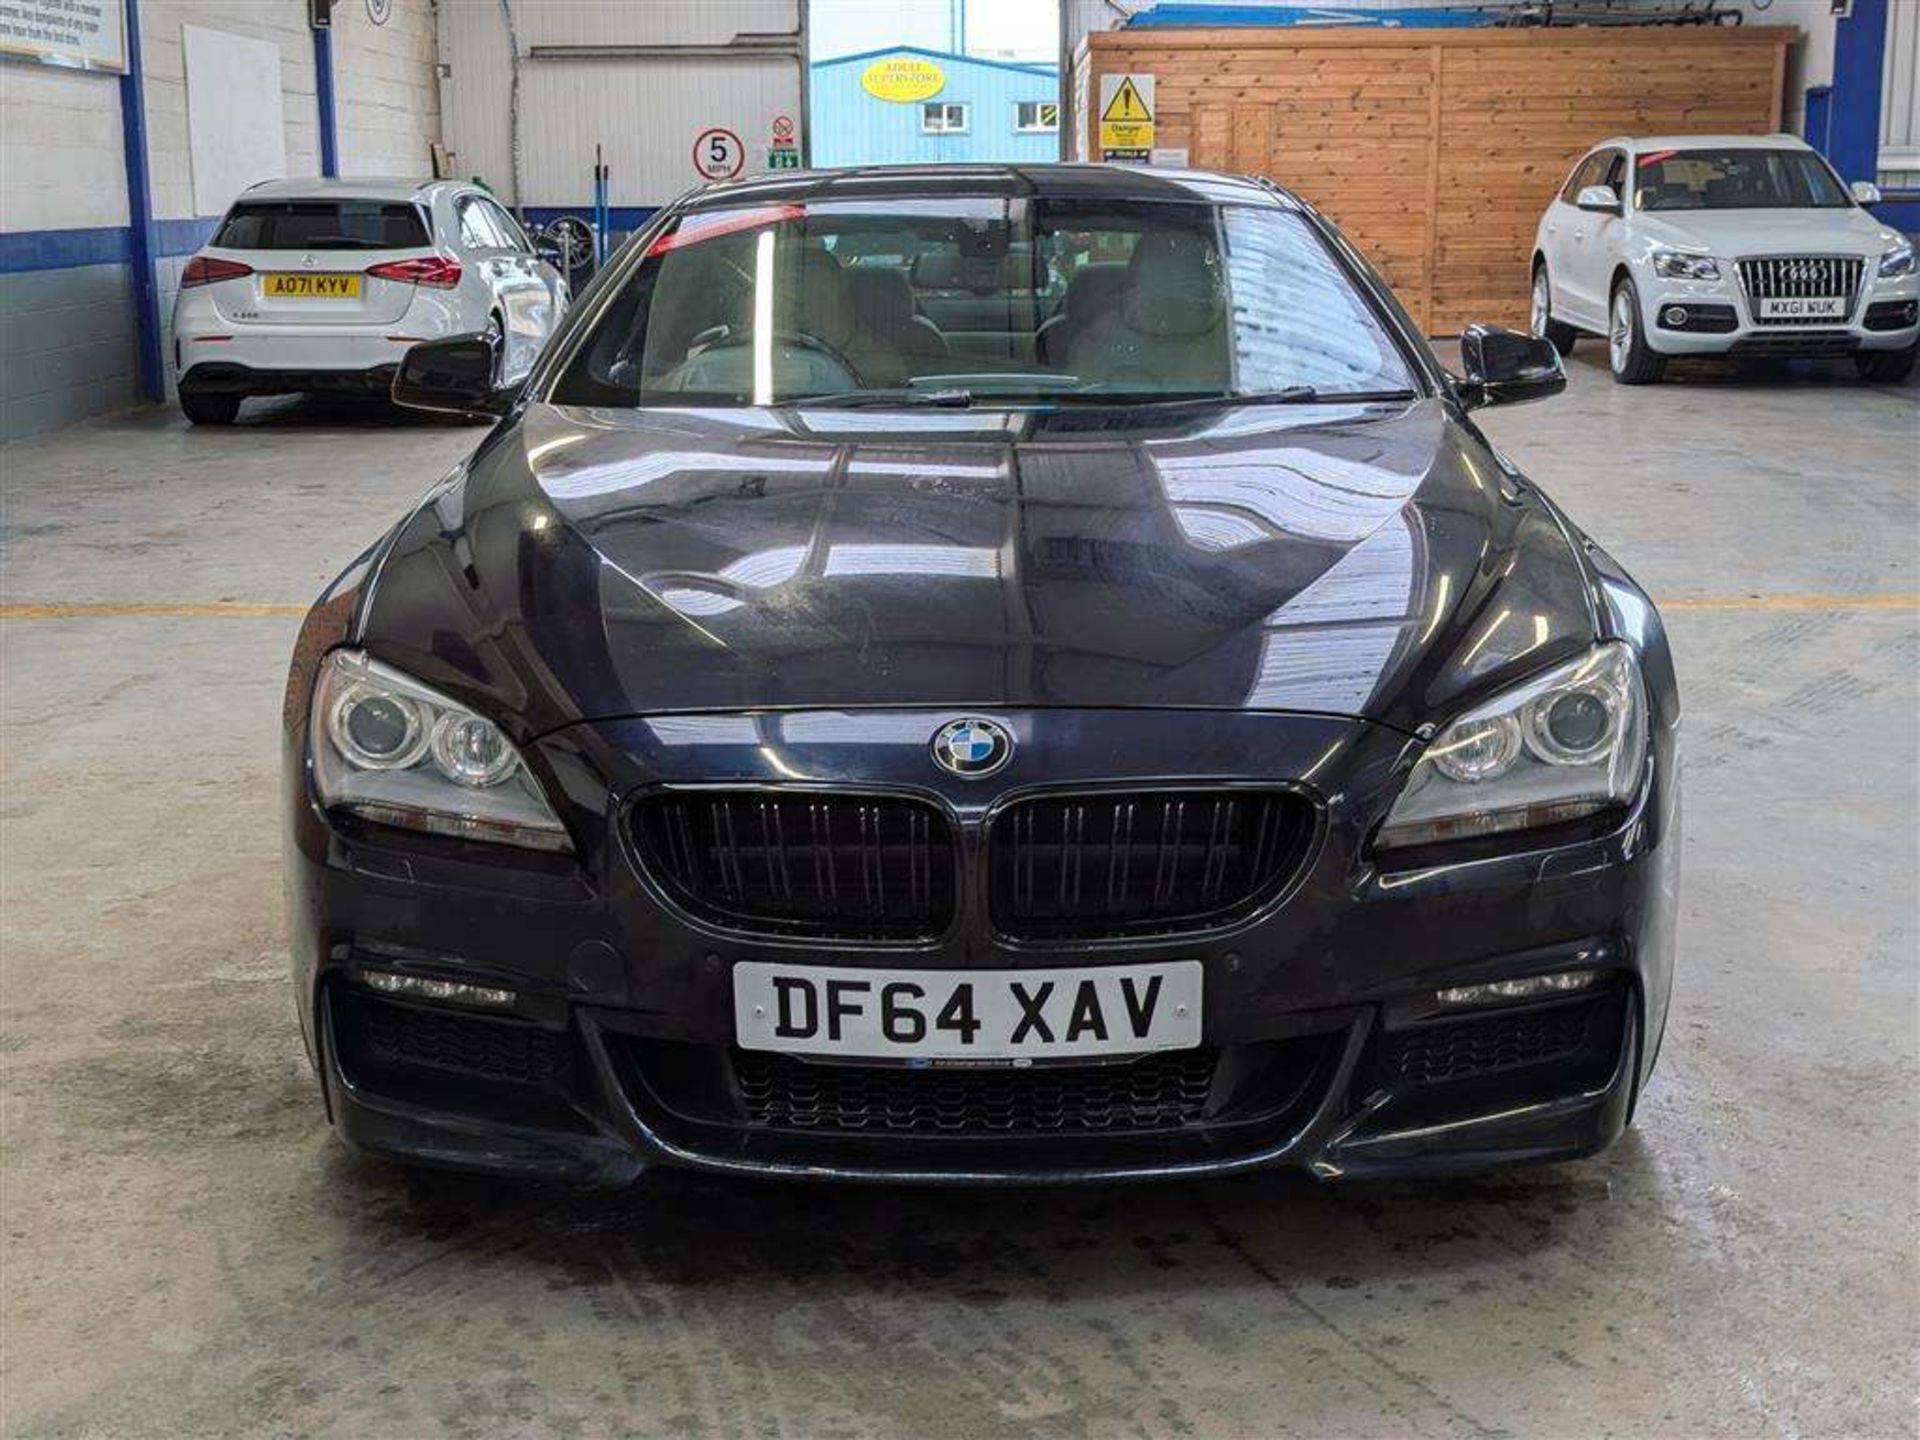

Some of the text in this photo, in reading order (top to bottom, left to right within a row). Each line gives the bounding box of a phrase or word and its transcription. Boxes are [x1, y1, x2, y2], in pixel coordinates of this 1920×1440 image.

[710, 137, 727, 162] 5
[707, 164, 731, 173] MPH
[275, 278, 349, 292] AO71 KYV
[771, 974, 1164, 1045] DF64 XAV
